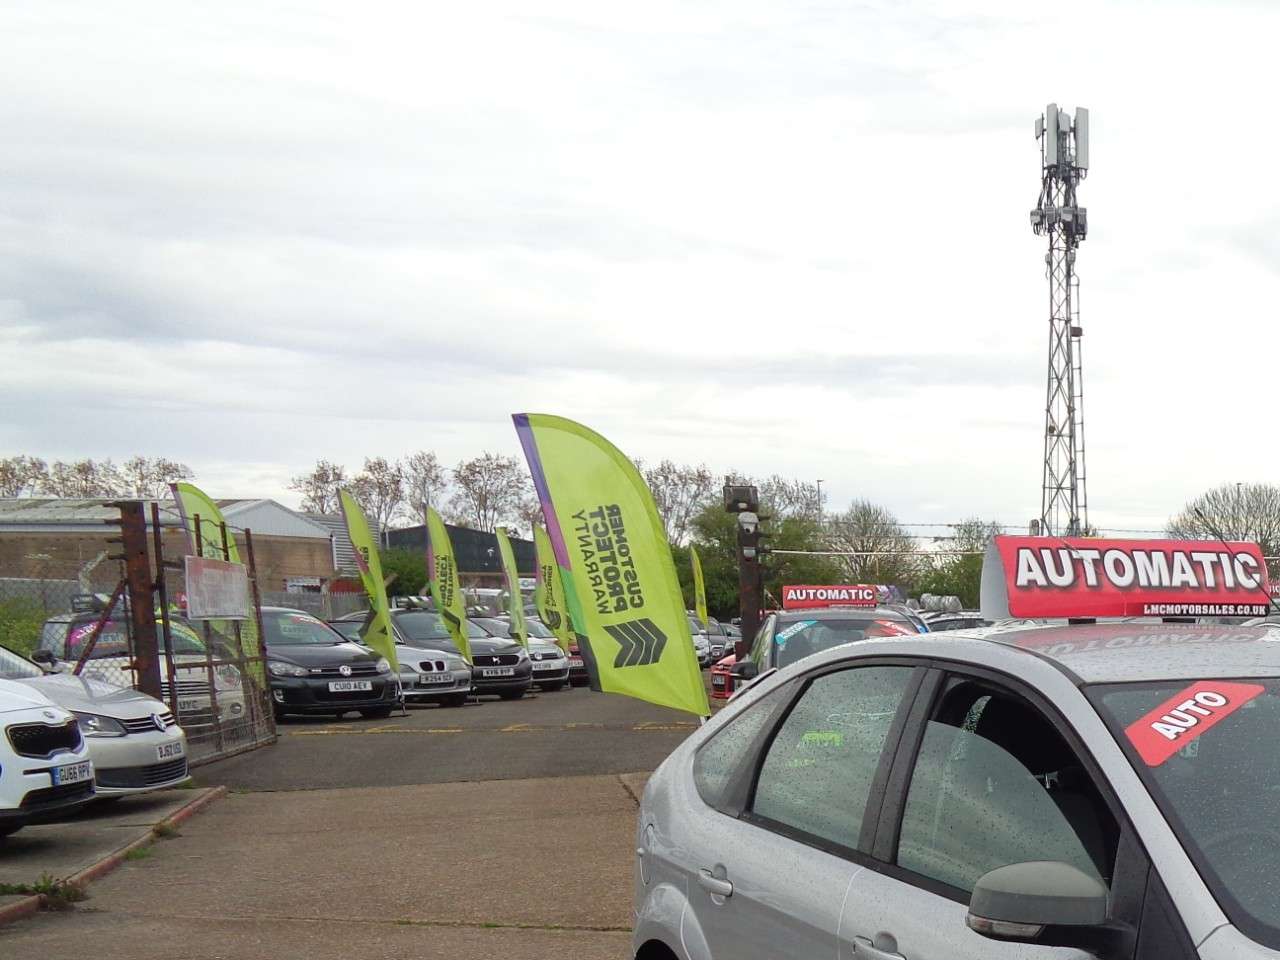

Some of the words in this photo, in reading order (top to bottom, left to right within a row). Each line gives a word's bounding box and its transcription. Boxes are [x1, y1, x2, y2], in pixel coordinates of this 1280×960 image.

[1016, 548, 1261, 590] AUTOMATIC
[786, 588, 874, 601] AUTOMATIC
[1143, 603, 1266, 616] LMCMOTORSALES.CO.UK
[1151, 690, 1228, 741] AUTO
